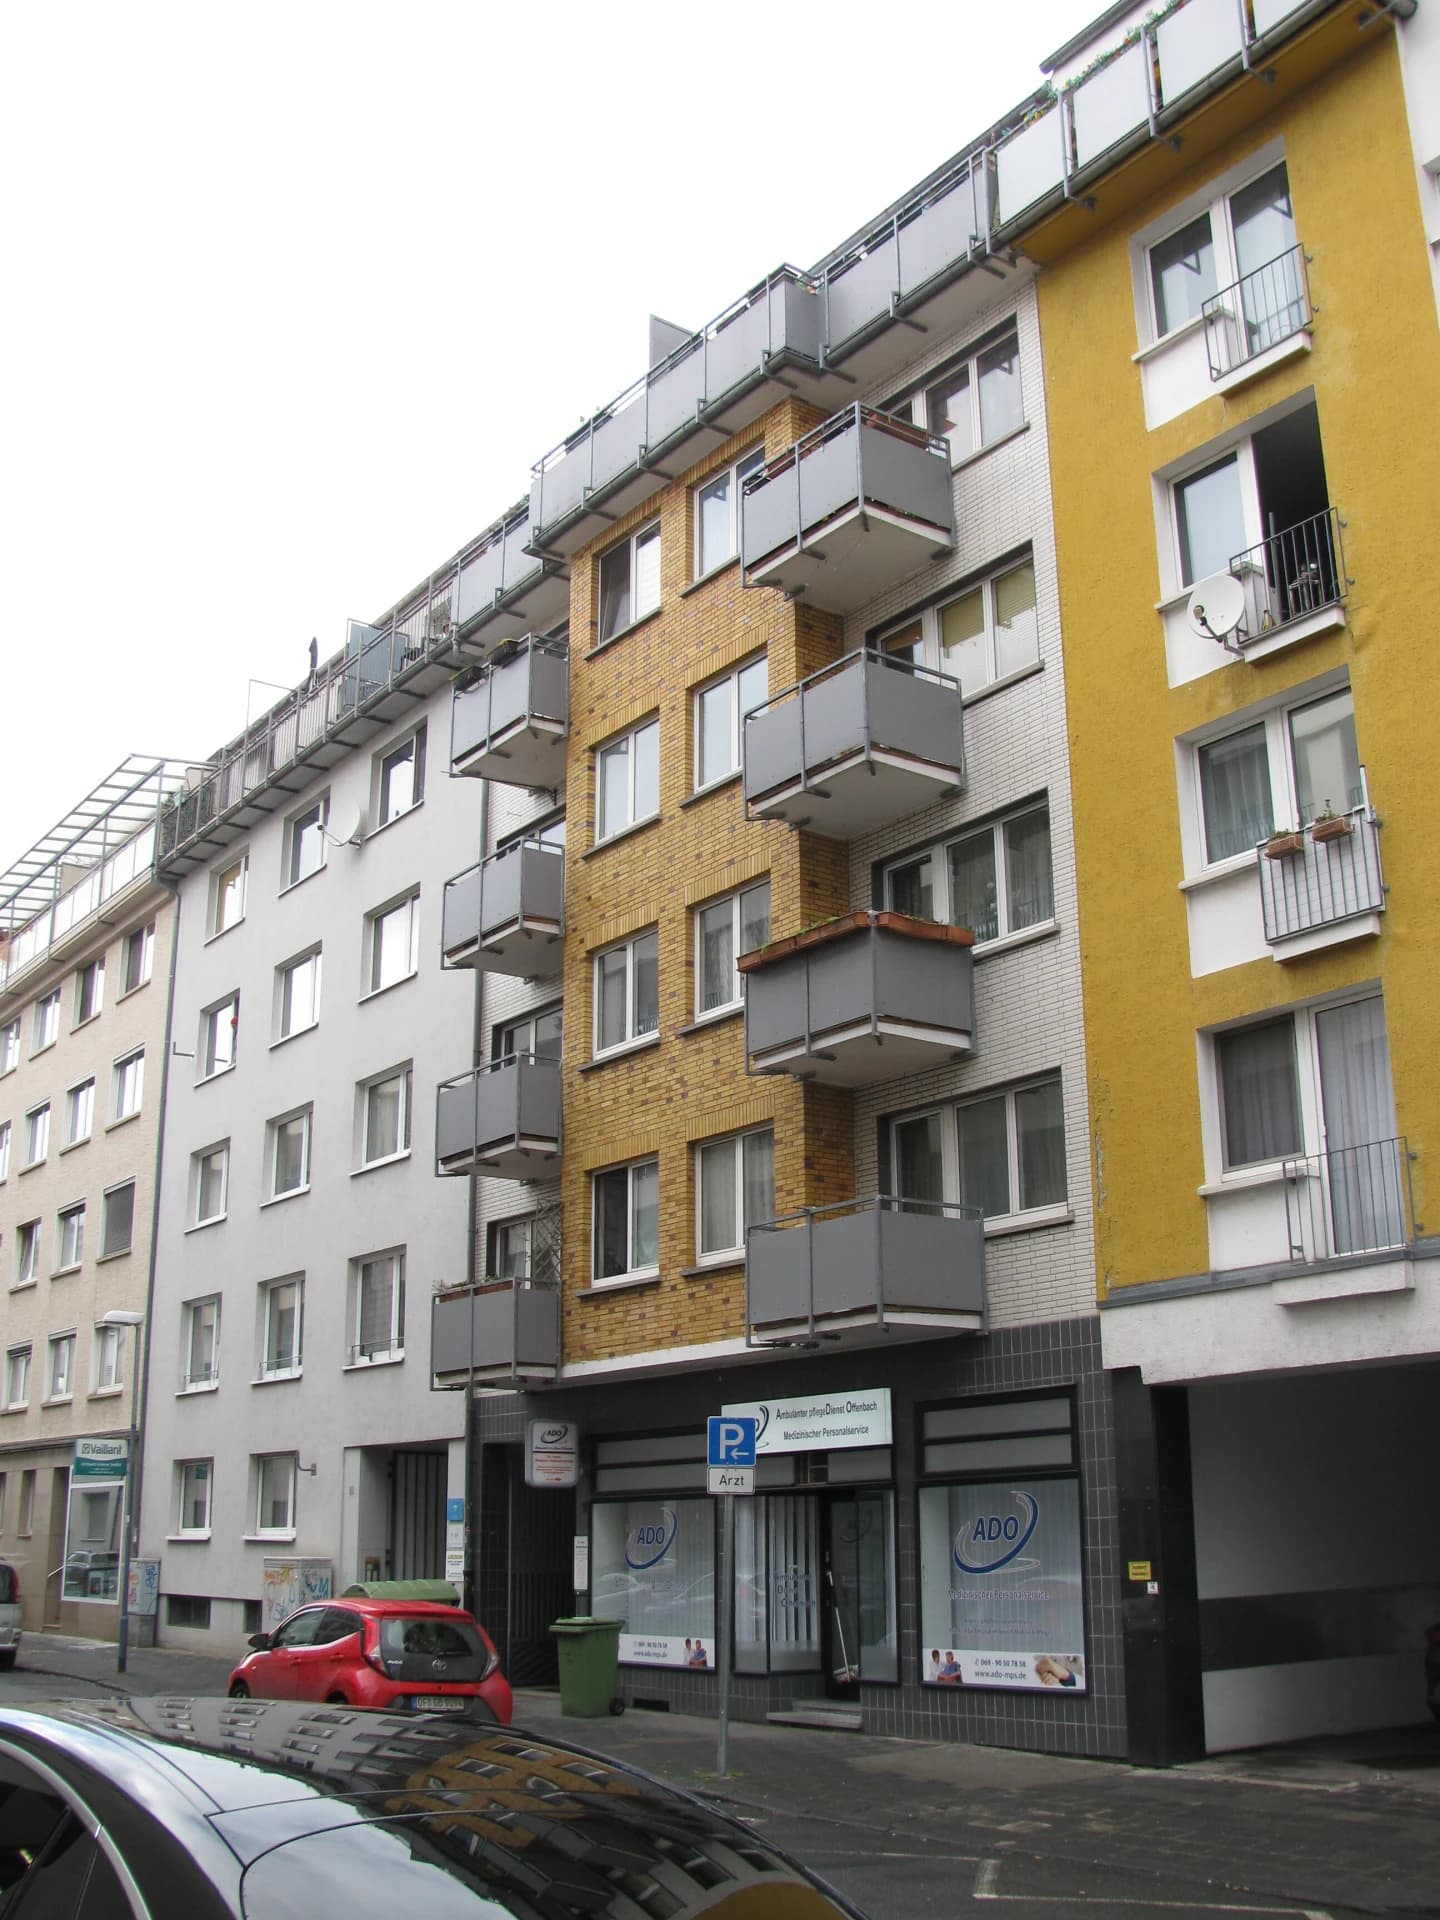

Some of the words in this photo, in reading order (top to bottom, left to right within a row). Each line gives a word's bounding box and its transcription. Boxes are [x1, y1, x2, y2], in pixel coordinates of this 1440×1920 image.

[776, 1407, 808, 1420] Ambulanter
[846, 1400, 878, 1413] Offenbach
[547, 1429, 562, 1437] ADO
[783, 1429, 822, 1440] Medizinischer
[822, 1425, 869, 1437] Personalservice
[719, 1423, 745, 1460] P
[90, 1443, 122, 1455] Vaillant
[719, 1474, 745, 1486] Arzt
[972, 1515, 1019, 1541] ADO
[637, 1526, 665, 1545] ADO
[994, 1589, 1050, 1600] Personalservice
[974, 1670, 1026, 1680] www.ado-mps.de
